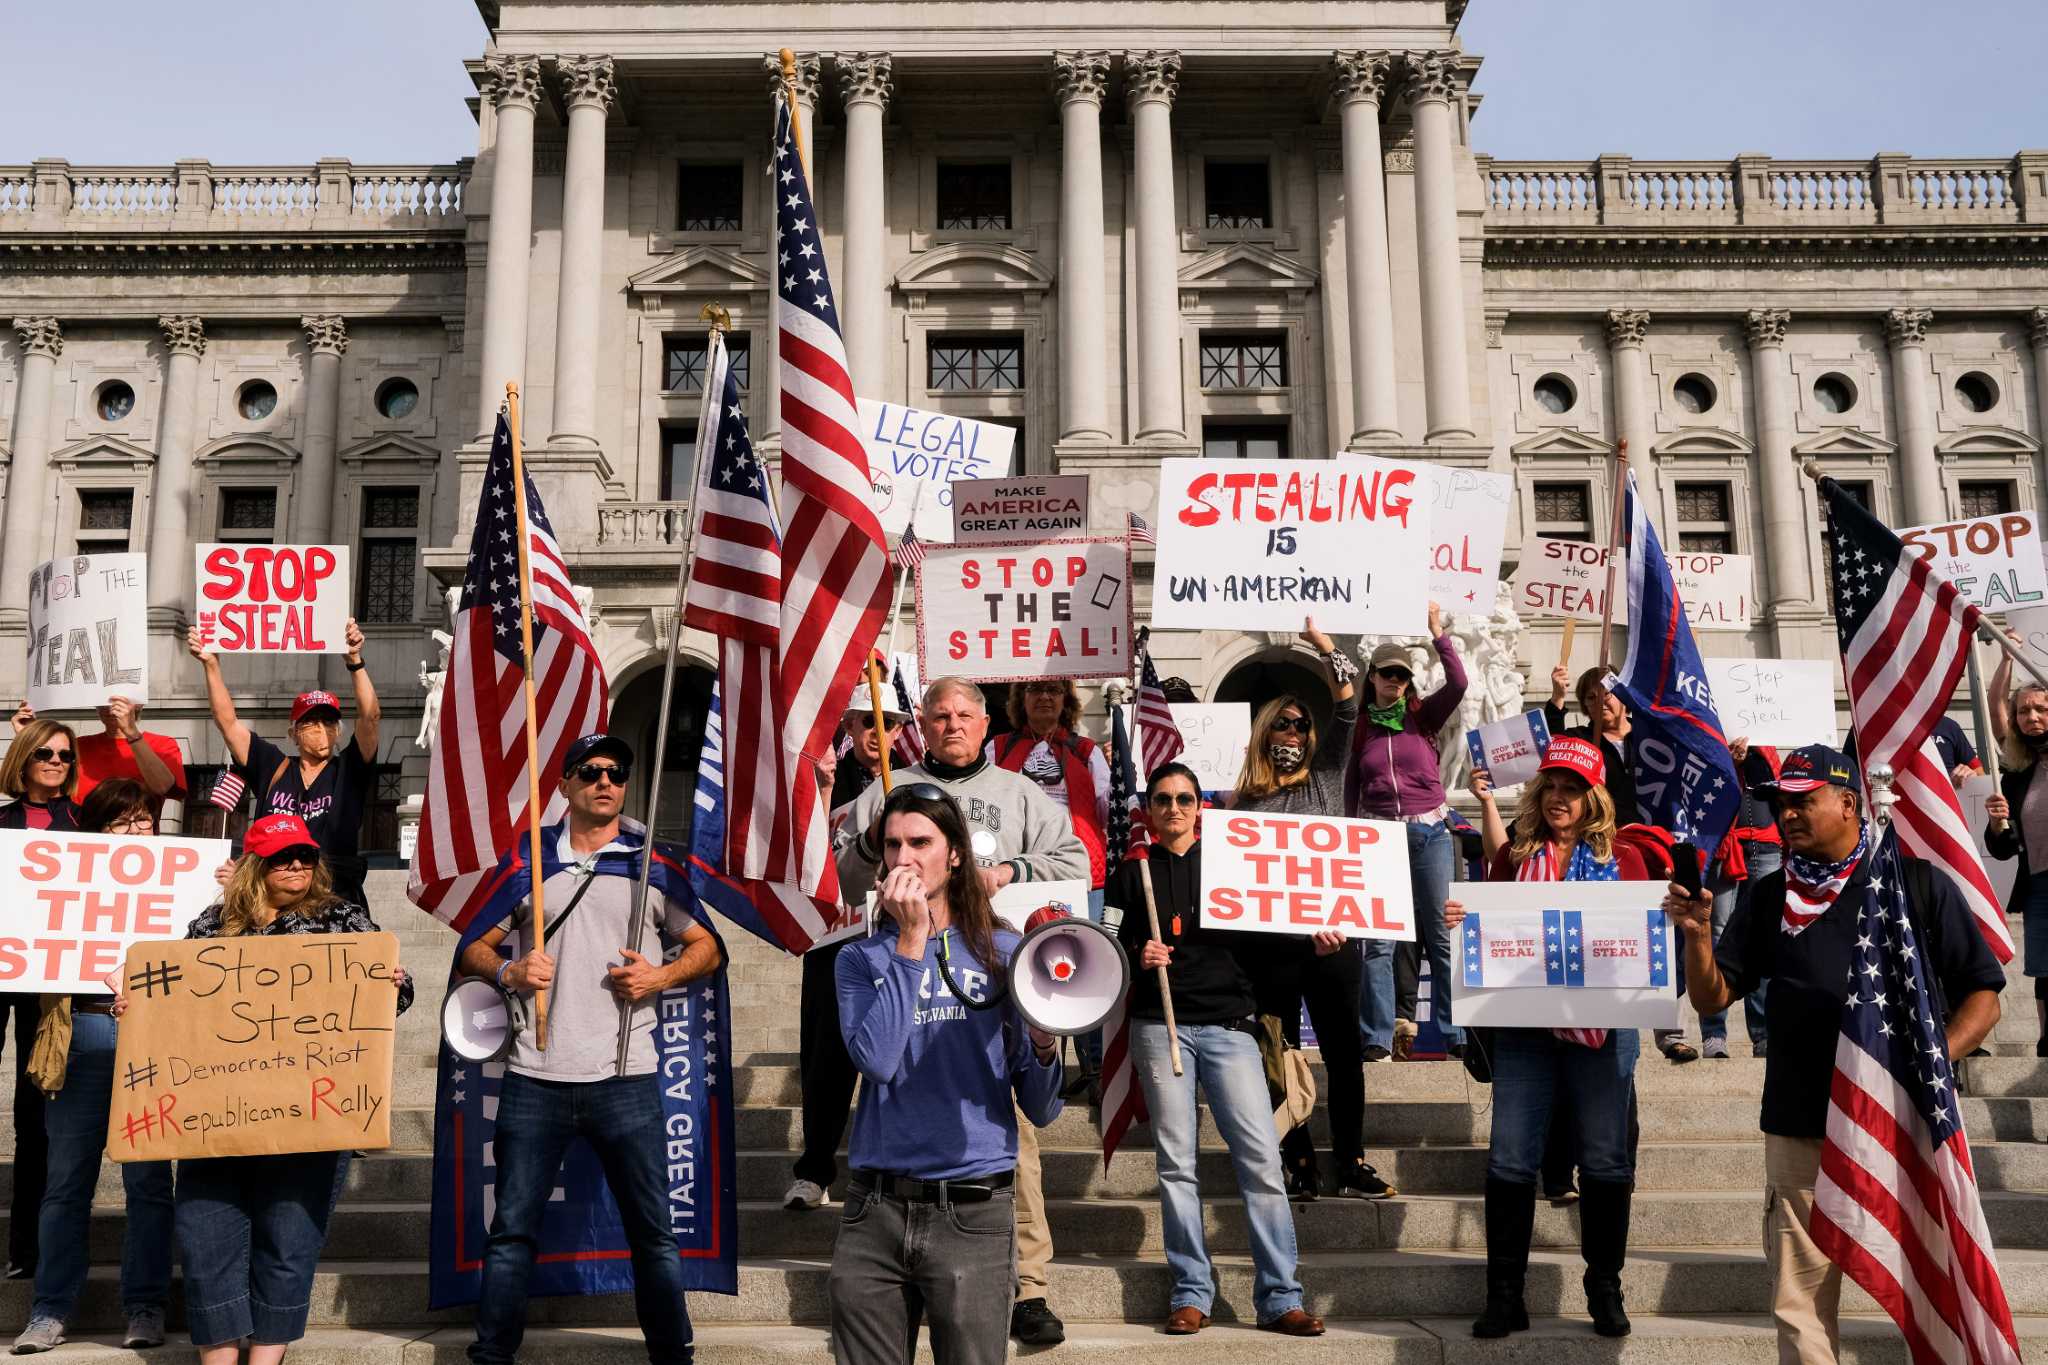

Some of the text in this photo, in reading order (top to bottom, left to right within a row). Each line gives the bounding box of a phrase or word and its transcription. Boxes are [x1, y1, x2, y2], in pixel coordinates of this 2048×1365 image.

[874, 403, 991, 464] LEGAL
[892, 450, 979, 482] VOTES
[995, 486, 1047, 497] MAKE
[1178, 469, 1417, 528] STEALING
[960, 499, 1081, 515] AMERICA
[960, 517, 1081, 531] GREAT AGAIN
[1901, 515, 2032, 562] STOP
[1266, 526, 1298, 556] IS
[100, 568, 138, 592] THE
[203, 547, 336, 602] STOP
[961, 556, 1087, 589] STOP
[1562, 566, 1589, 578] the
[1945, 561, 1971, 577] the
[1955, 569, 2043, 608] EAL
[984, 592, 1071, 623] THE
[1682, 595, 1743, 623] EAL!
[200, 611, 216, 647] THE
[219, 603, 326, 650] STEAL
[27, 618, 142, 687] STEAL
[949, 627, 1119, 660] STEAL!
[1728, 664, 1784, 693] Stop
[1755, 694, 1776, 704] the
[1491, 740, 1526, 755] STOP THE
[1493, 748, 1529, 764] STEAL
[1549, 742, 1600, 761] MAKE AMERICA
[1549, 752, 1593, 769] GREAT AGAIN
[1226, 817, 1380, 854] STOP
[20, 840, 199, 886] STOP
[1244, 853, 1366, 890] THE
[37, 890, 172, 933] THE
[1208, 887, 1405, 931] STEAL
[1490, 947, 1535, 958] STEAL
[1592, 939, 1618, 947] STOP
[1592, 947, 1638, 958] STEAL
[0, 937, 130, 982] STE
[912, 1005, 967, 1025] SYLVANIA
[306, 1040, 369, 1070] Riot
[120, 1076, 383, 1148] #Republicans Rally
